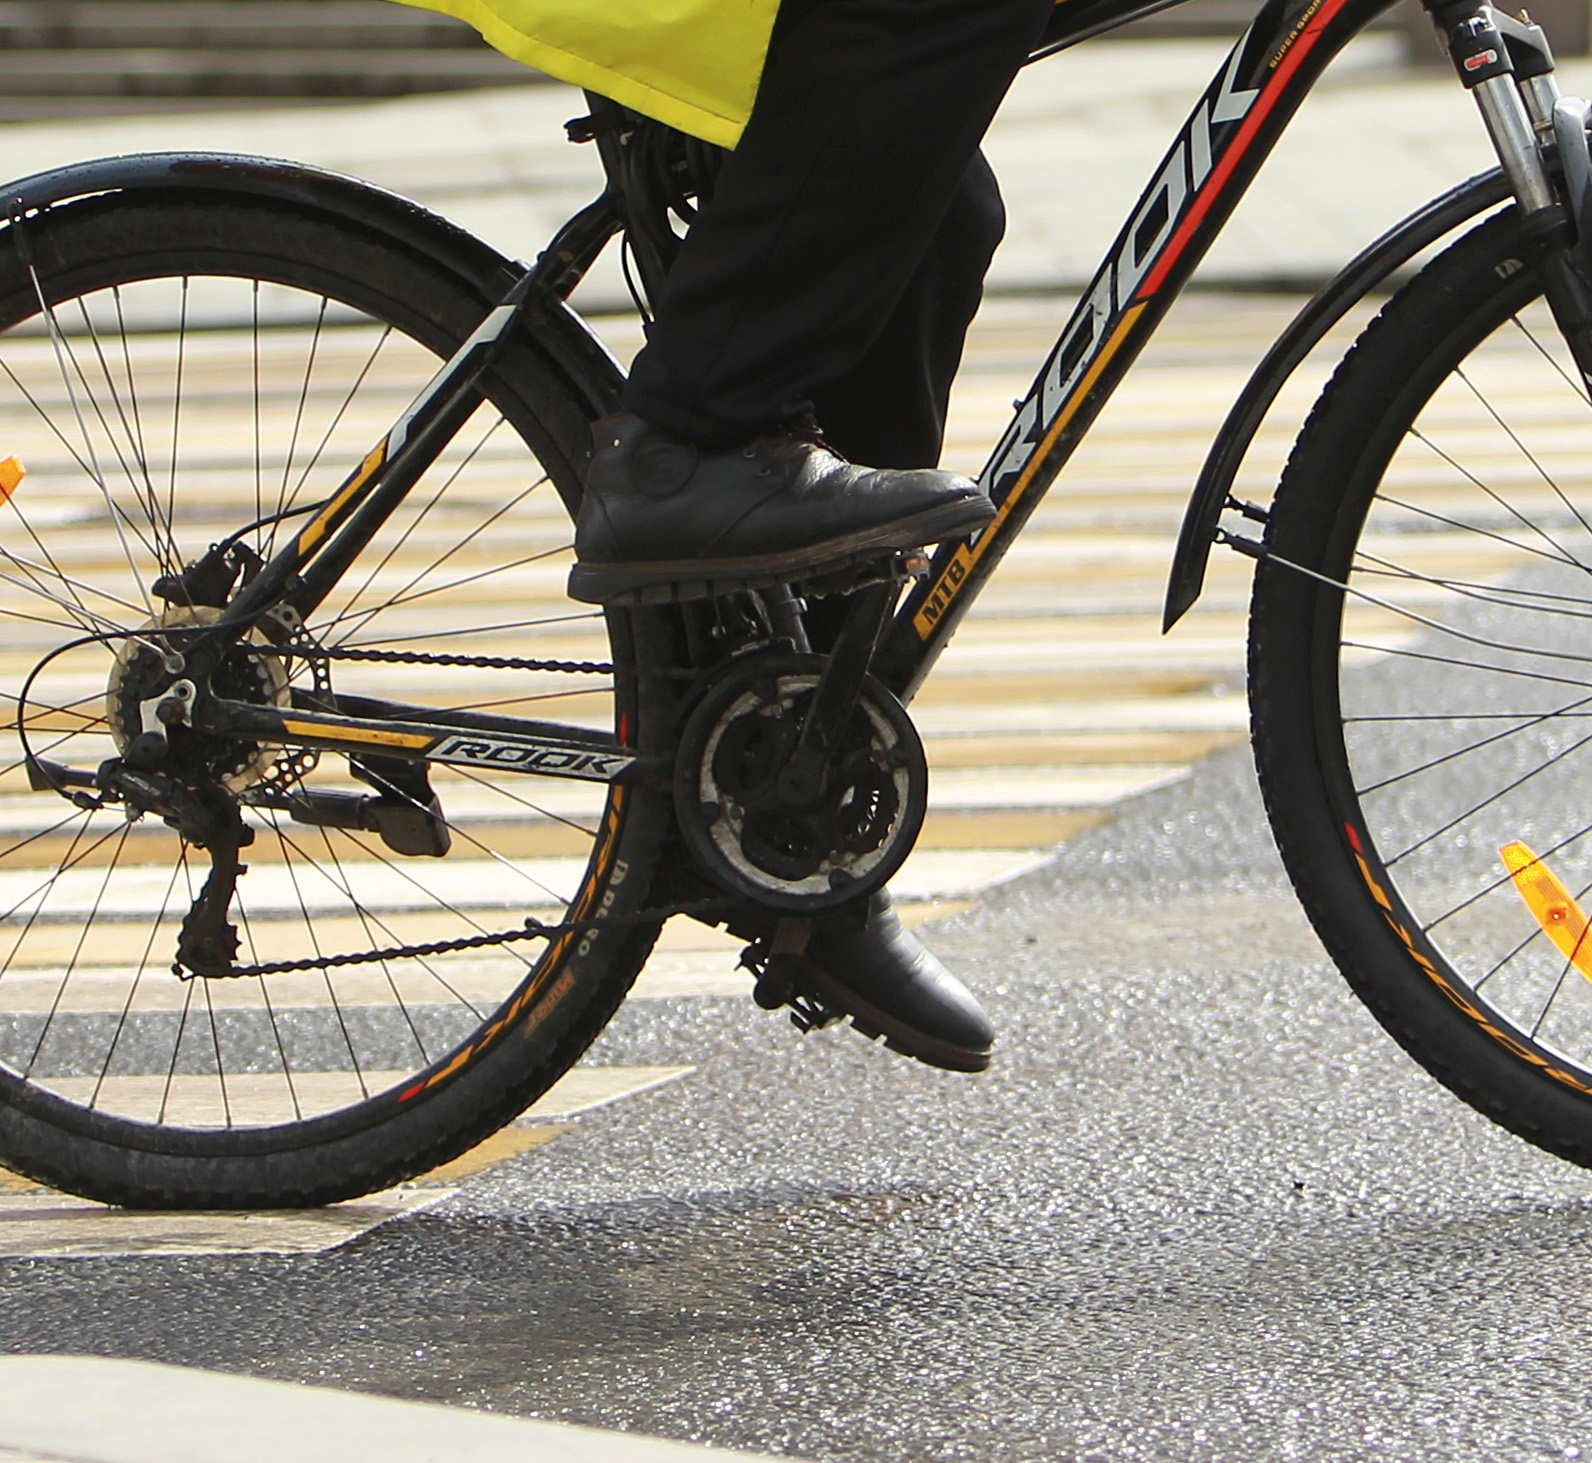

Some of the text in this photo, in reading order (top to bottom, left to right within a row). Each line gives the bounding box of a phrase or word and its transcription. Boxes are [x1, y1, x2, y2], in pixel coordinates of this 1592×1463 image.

[1269, 30, 1299, 69] SUPER
[970, 24, 1260, 546] ROOK
[922, 558, 966, 626] MTB
[441, 740, 624, 774] ROOK
